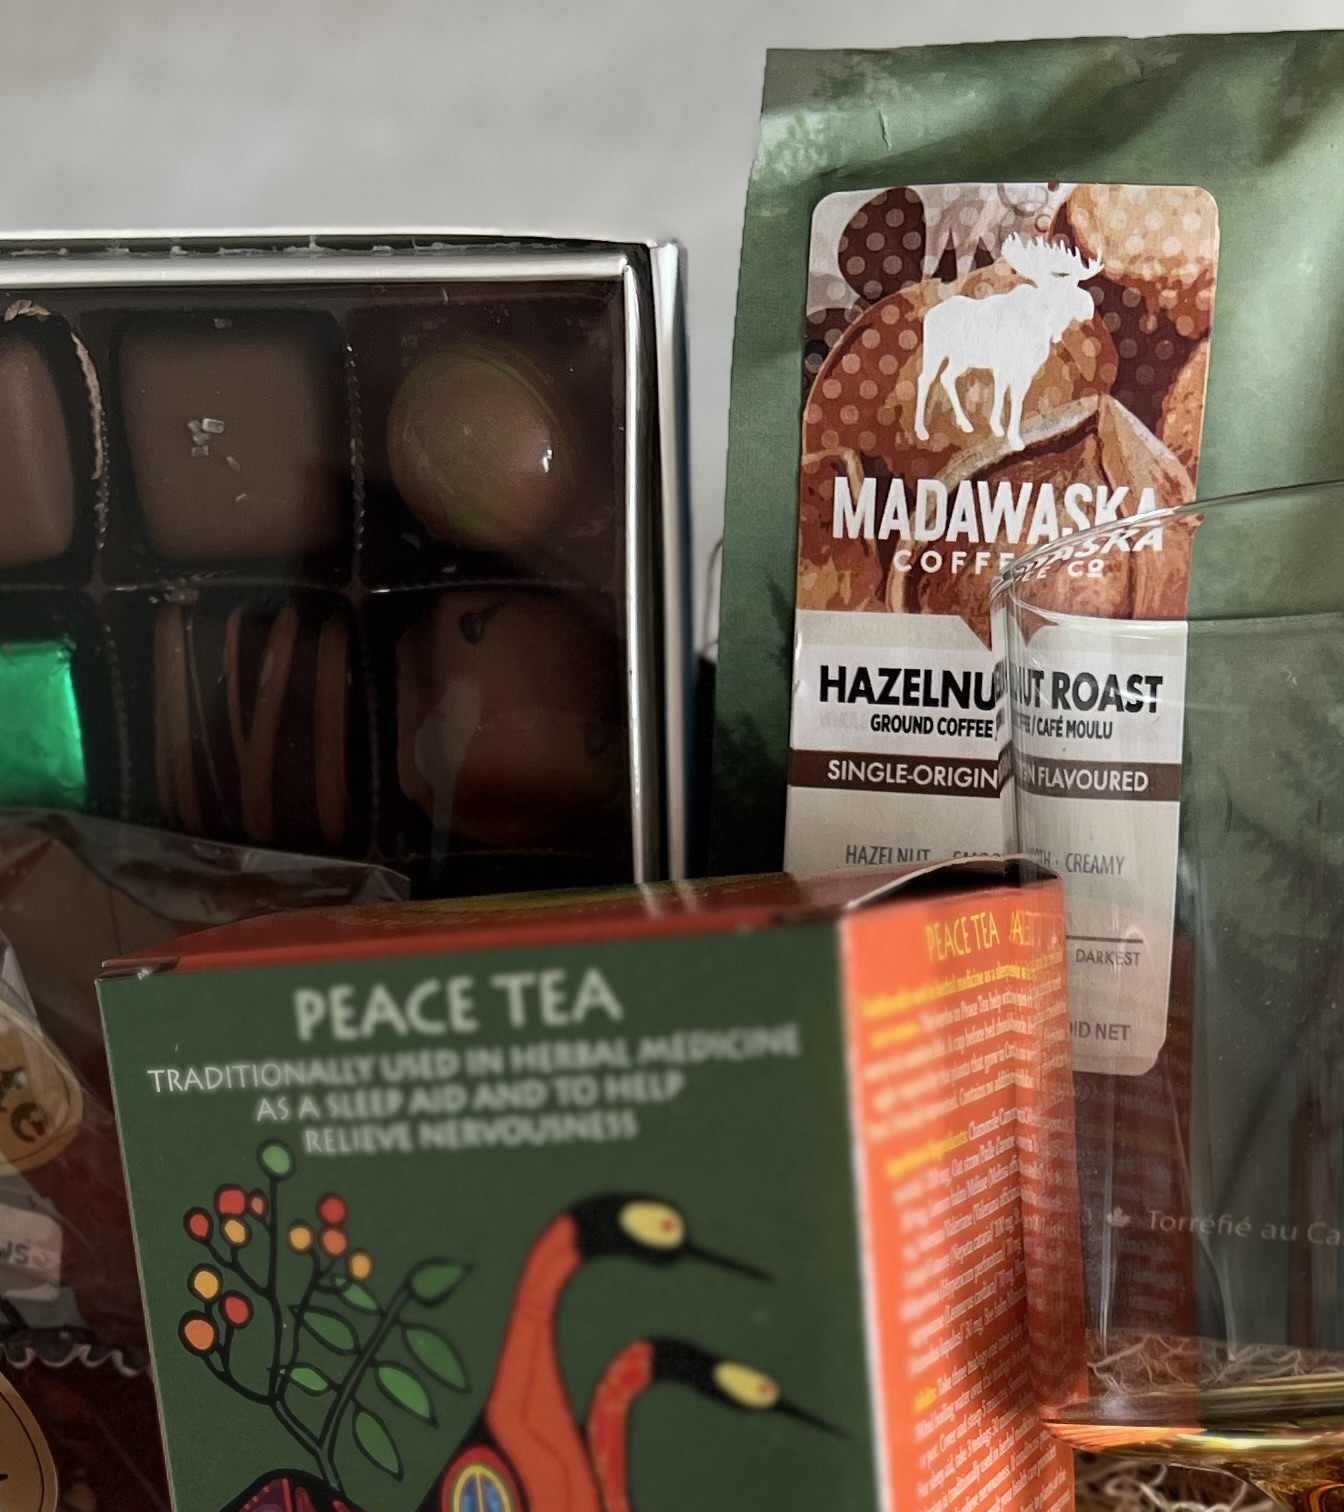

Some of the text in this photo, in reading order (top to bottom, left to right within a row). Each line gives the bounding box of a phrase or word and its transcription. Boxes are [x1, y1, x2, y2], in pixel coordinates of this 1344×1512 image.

[832, 476, 1163, 552] MADAWASKA
[819, 665, 1163, 715] HAZELNUT ROAST
[870, 713, 934, 736] GROUND
[937, 716, 994, 739] COFFEE
[1036, 714, 1063, 738] CAFÉ
[1066, 719, 1113, 740] MOULU
[827, 758, 1149, 793] SINGLE-ORIGIN FLAVOURED
[1065, 851, 1126, 875] CREAMY
[925, 914, 971, 964] PEACE
[971, 911, 1000, 950] TEA
[1075, 948, 1141, 967] DARKEST
[293, 968, 623, 1042] PEACE TEA
[1095, 1023, 1131, 1041] NET
[147, 1023, 800, 1093] TRADITIONALLY USED IN HERBAL MEDICINE
[256, 1069, 686, 1122] AS A SLEEP AID AND TO HELP
[306, 1110, 638, 1155] RELIEVE NERVOUSNESS
[1146, 1209, 1252, 1238] Torréfié
[1260, 1223, 1299, 1240] au
